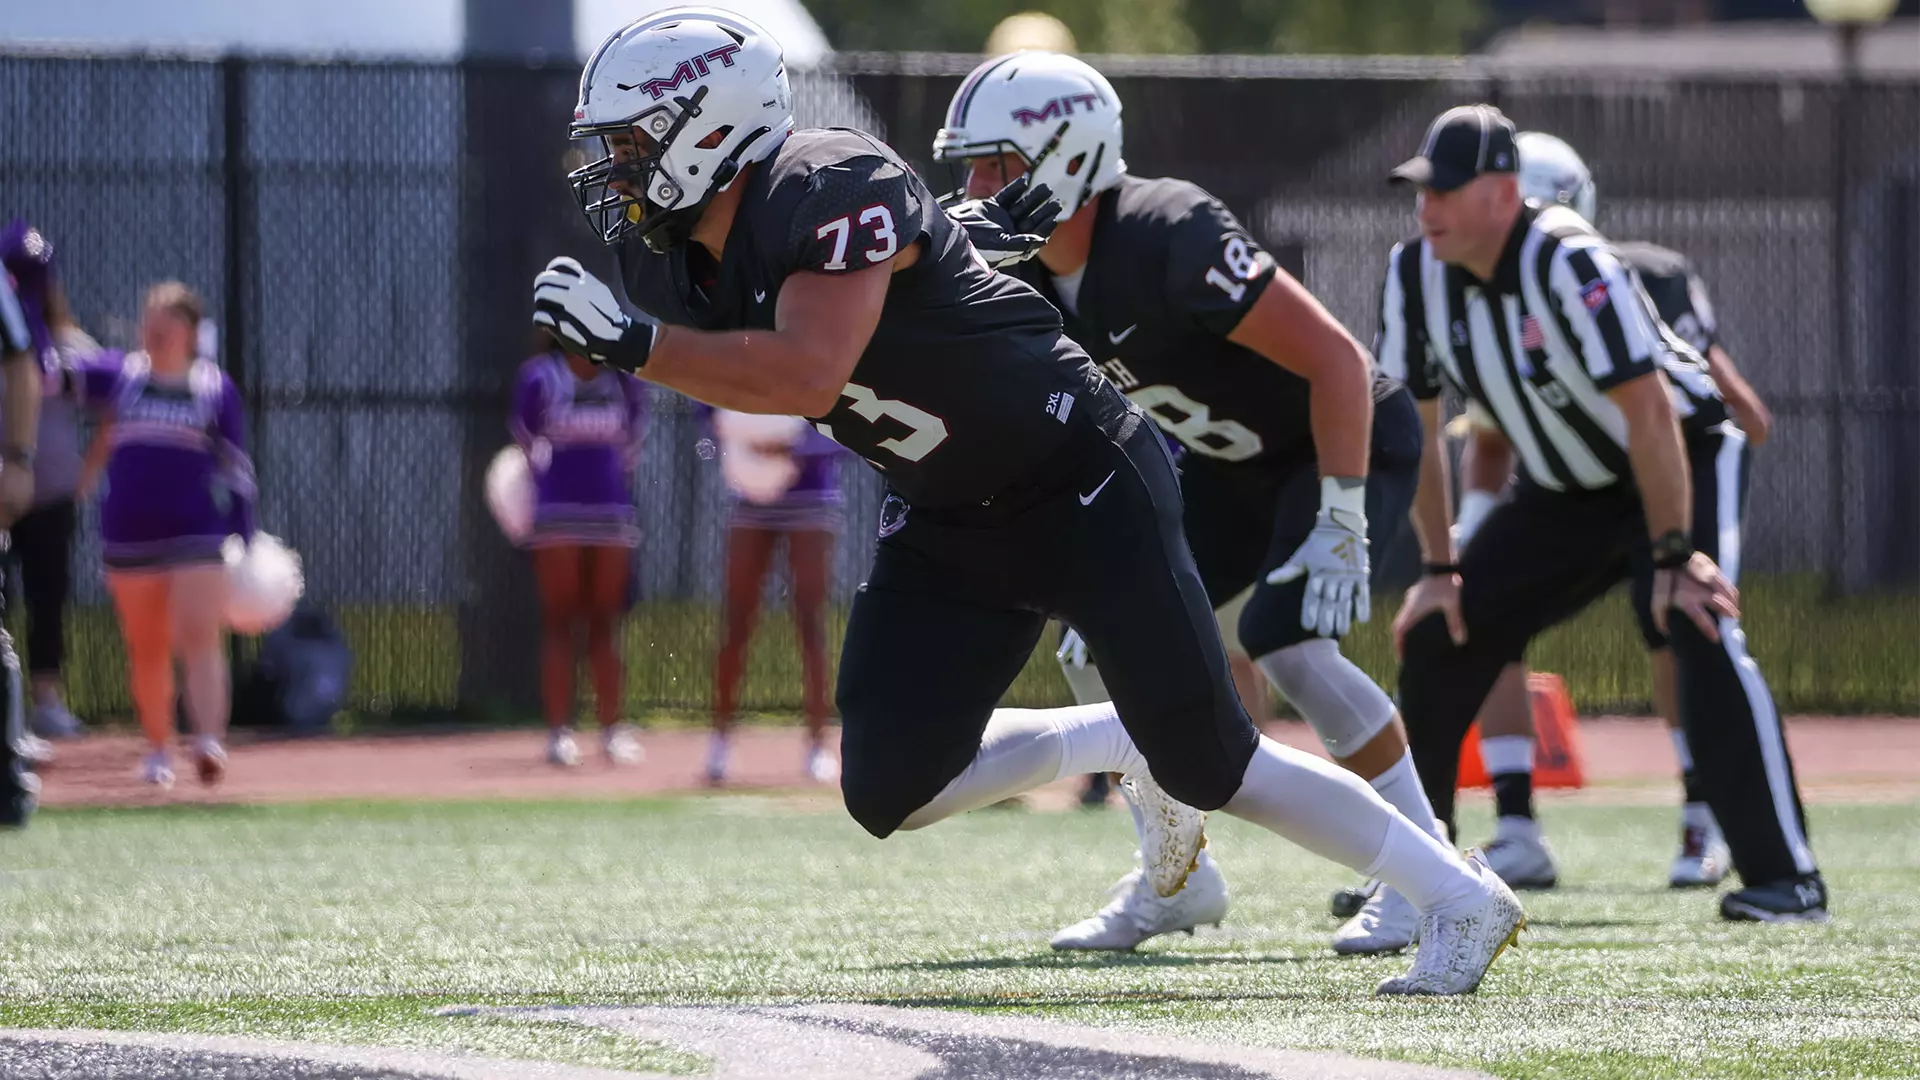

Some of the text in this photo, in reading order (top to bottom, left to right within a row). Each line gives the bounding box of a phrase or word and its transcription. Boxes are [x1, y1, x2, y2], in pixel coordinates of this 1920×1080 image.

[640, 43, 741, 100] MIT
[1011, 93, 1097, 126] MIT
[814, 203, 898, 271] 73
[1205, 237, 1259, 302] 18
[816, 382, 949, 463] 3
[1045, 391, 1061, 415] 2XL
[1126, 384, 1263, 462] 8
